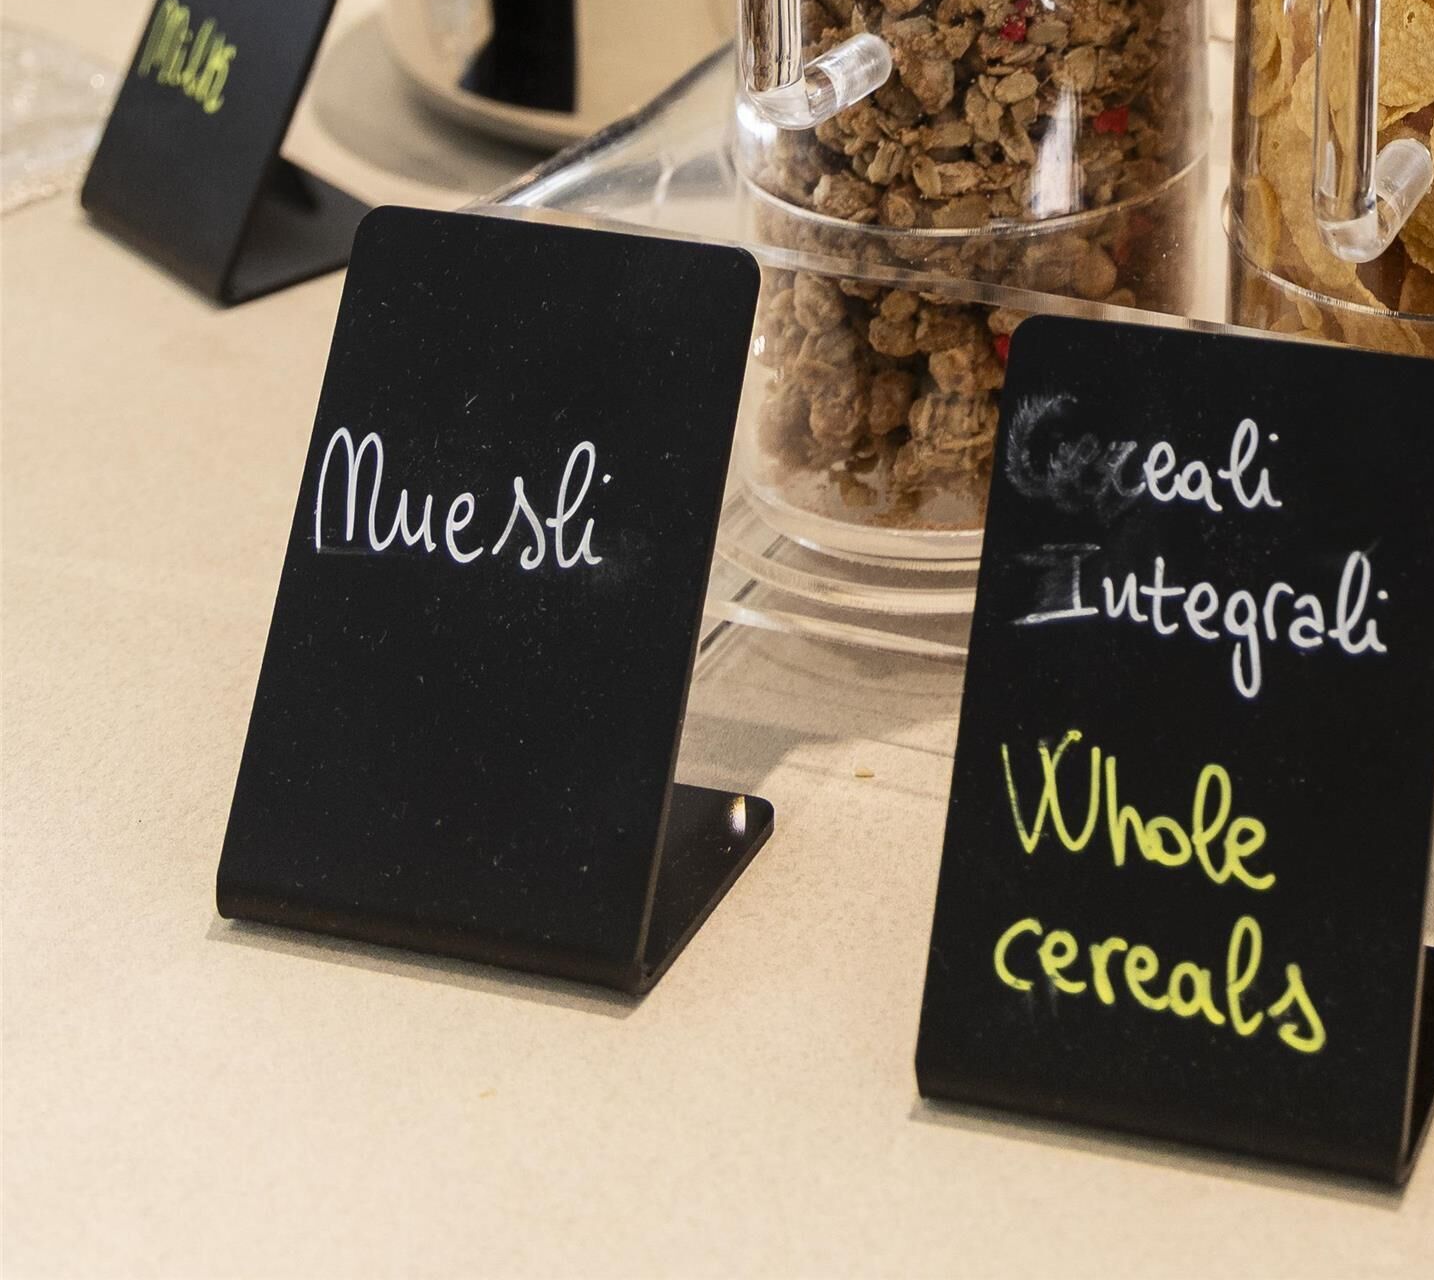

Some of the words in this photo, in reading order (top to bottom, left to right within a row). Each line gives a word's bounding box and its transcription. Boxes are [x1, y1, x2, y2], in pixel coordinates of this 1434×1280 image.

[315, 427, 612, 569] Muesli
[1013, 543, 1390, 697] Integrali
[1002, 730, 1276, 891] Whole
[994, 915, 1327, 1052] cereals
